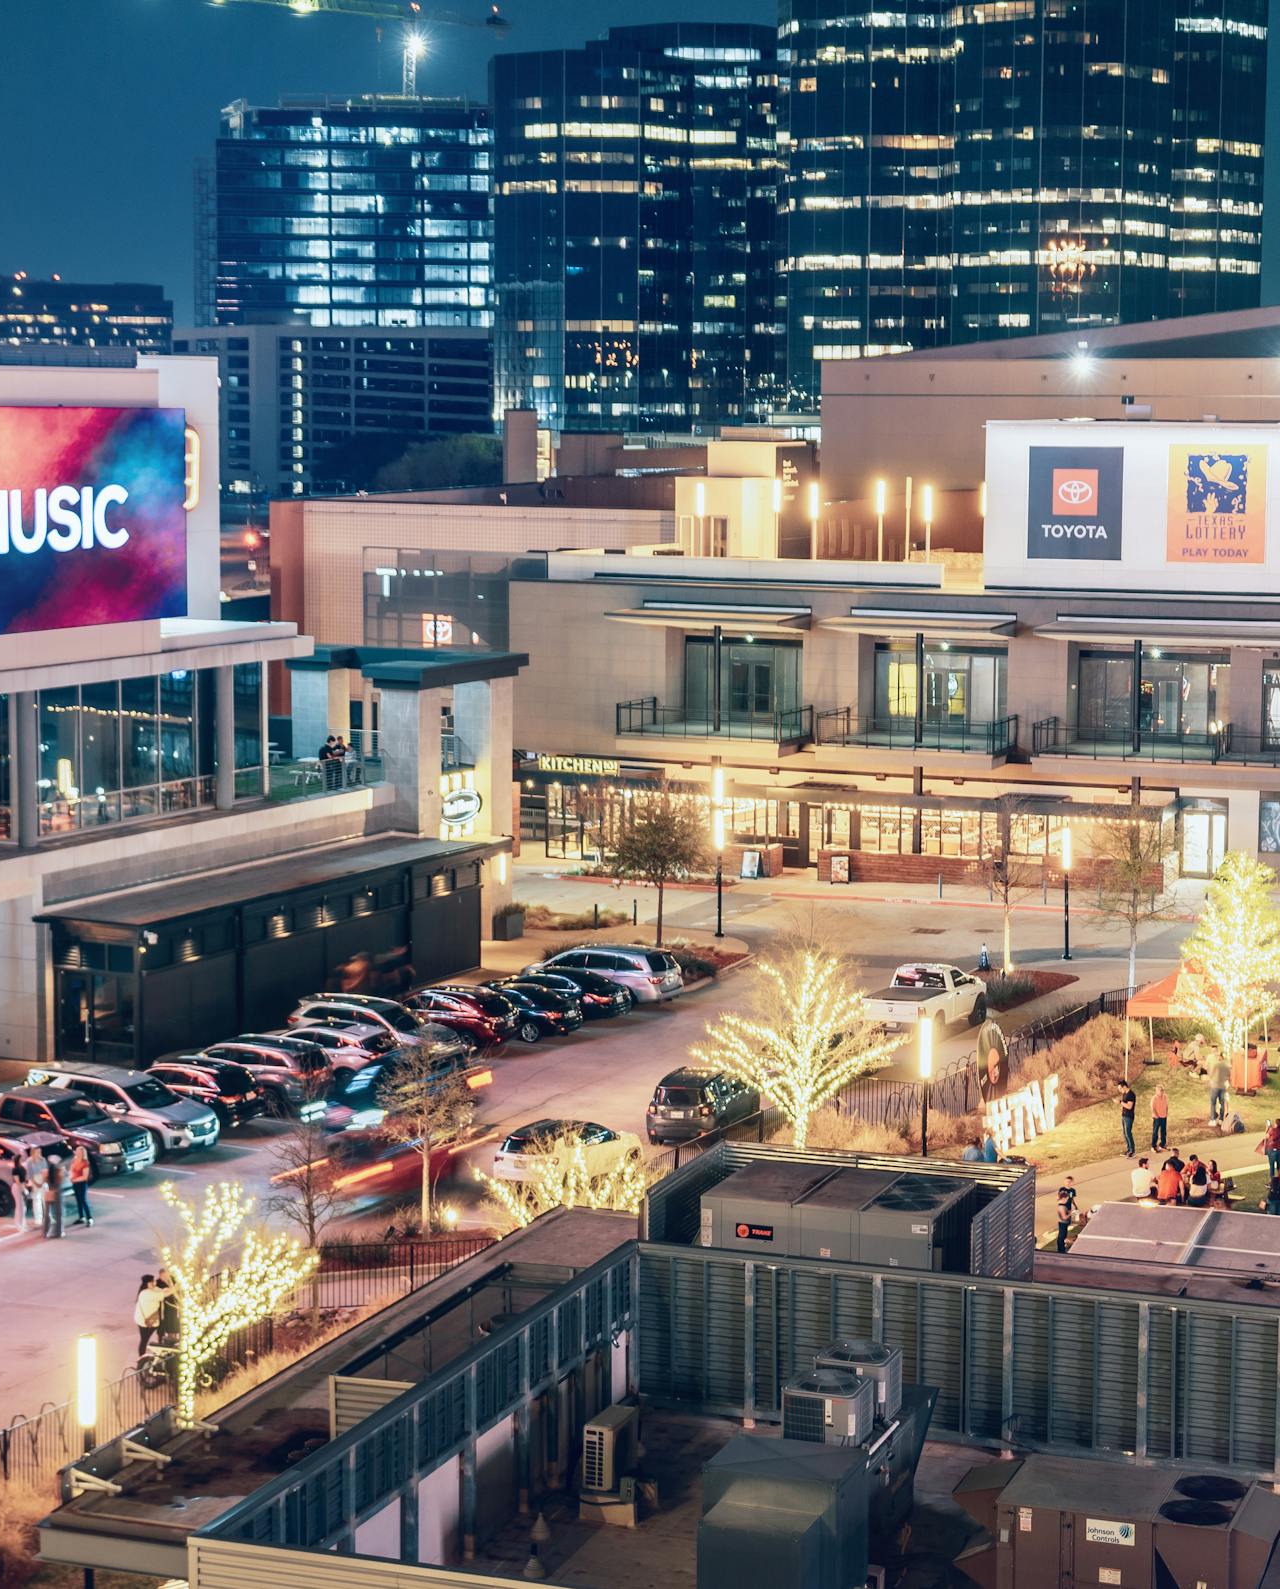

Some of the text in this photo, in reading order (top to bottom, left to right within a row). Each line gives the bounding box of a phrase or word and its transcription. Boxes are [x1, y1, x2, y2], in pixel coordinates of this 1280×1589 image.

[1197, 515, 1234, 526] TEXAS
[1041, 524, 1108, 539] TOYOTA
[1185, 526, 1247, 541] LOTTERY
[1182, 548, 1249, 558] PLAY TODAY
[542, 756, 603, 774] KITCHEN
[982, 1073, 1059, 1153] #TMF
[1087, 1526, 1115, 1536] Johnson
[1092, 1534, 1120, 1544] Controls
